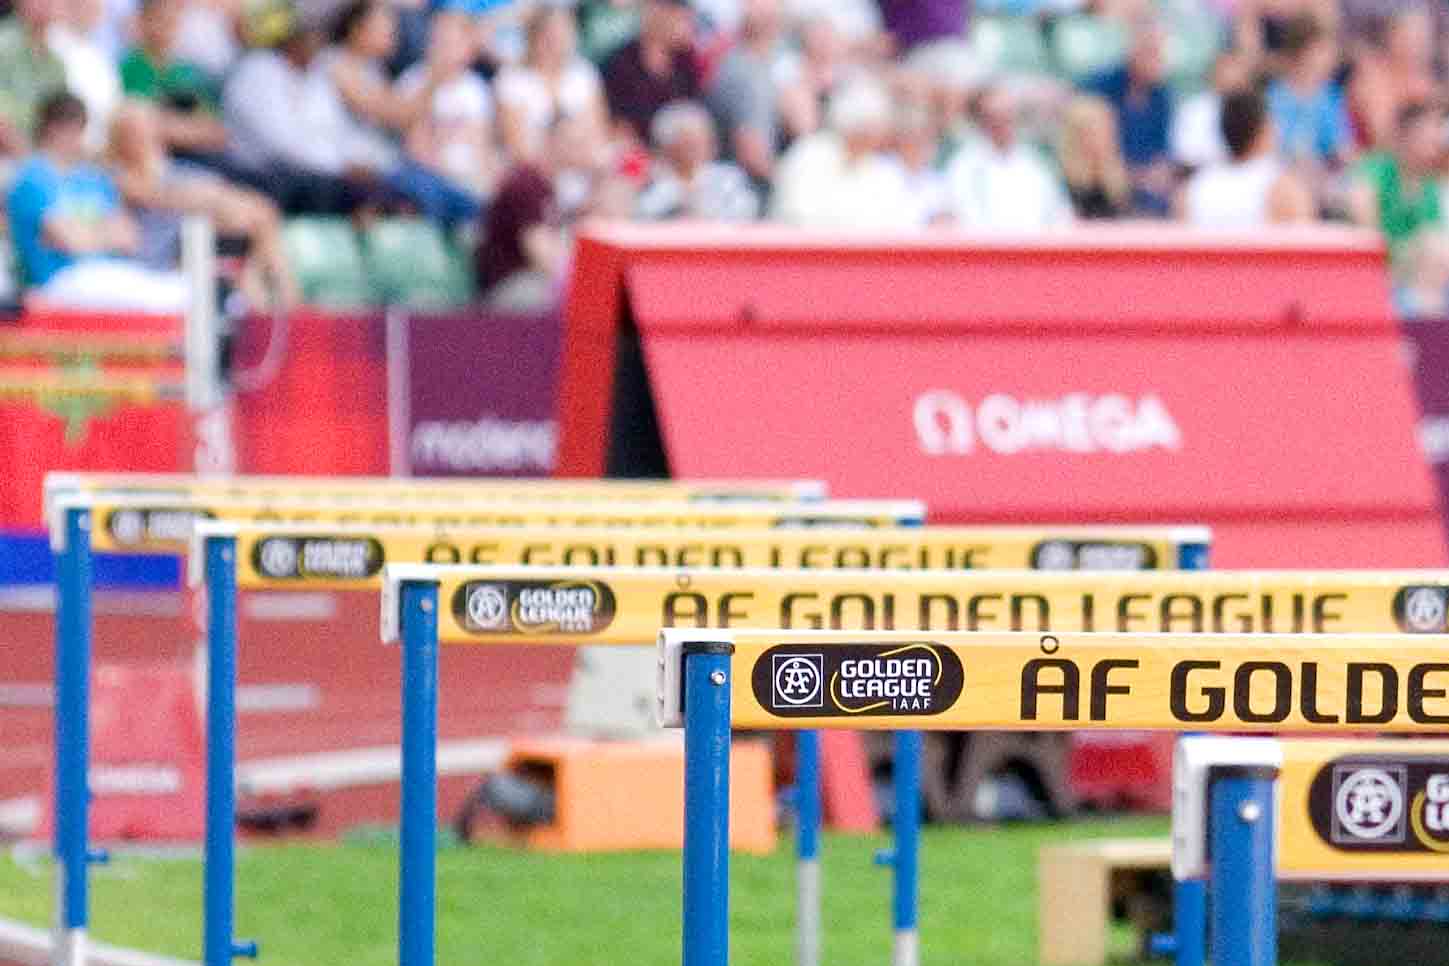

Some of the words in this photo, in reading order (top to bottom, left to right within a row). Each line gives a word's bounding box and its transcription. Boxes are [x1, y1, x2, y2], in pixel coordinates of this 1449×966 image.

[976, 390, 1183, 454] OMEGA
[839, 658, 932, 679] GOLDEN
[1019, 634, 1140, 722] ÅF
[839, 678, 932, 698] LEAGUE
[892, 698, 932, 710] IAAF
